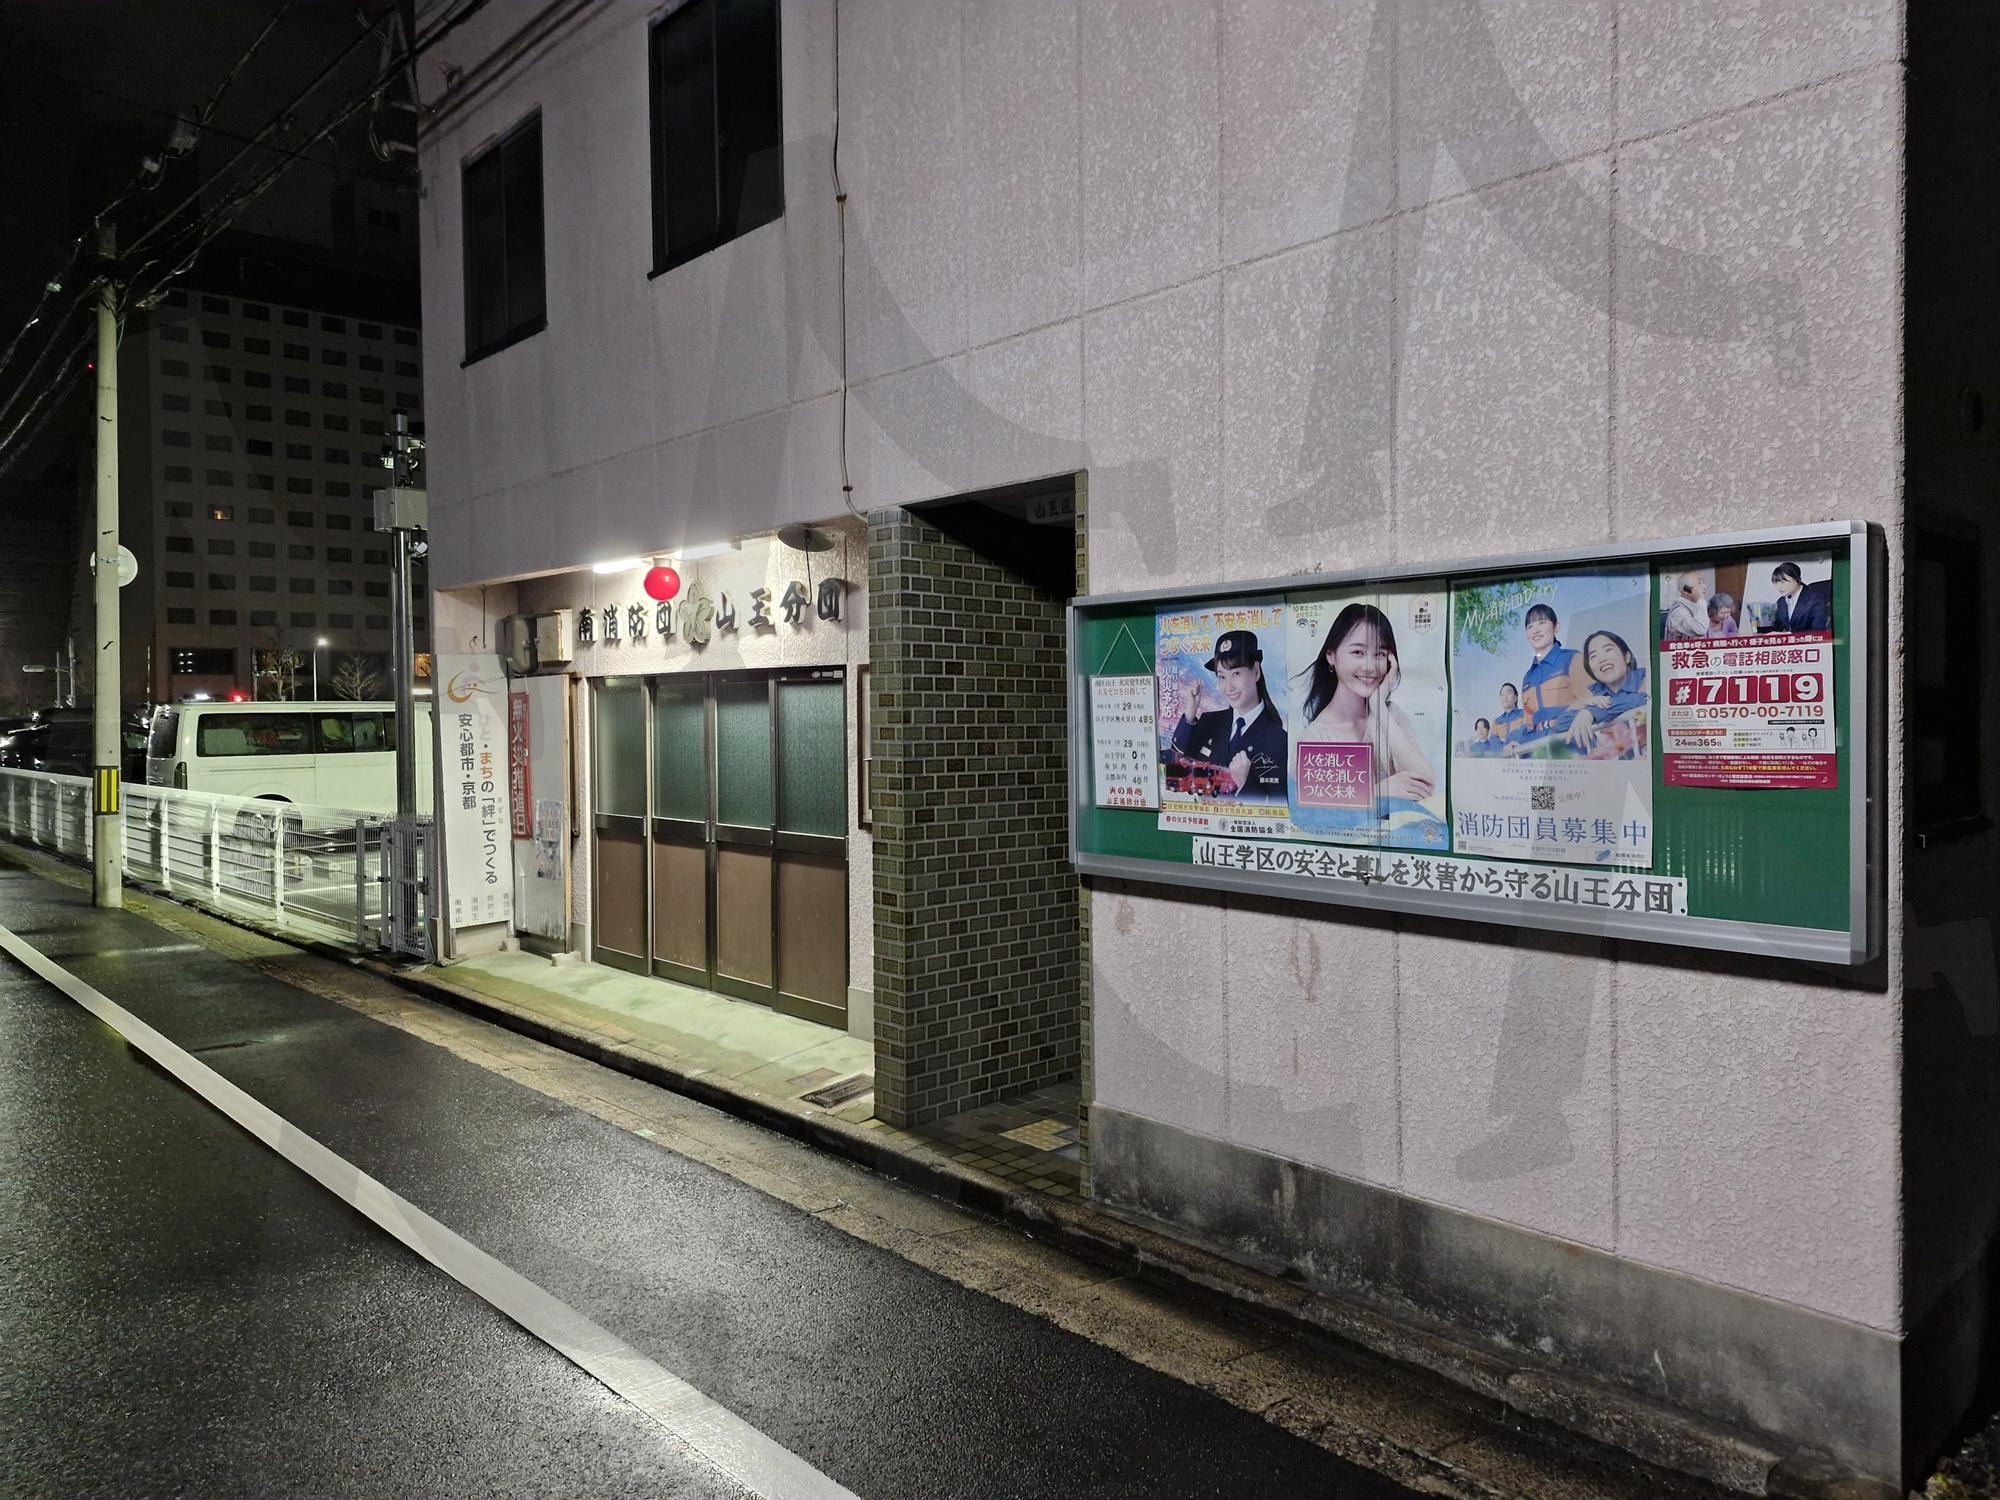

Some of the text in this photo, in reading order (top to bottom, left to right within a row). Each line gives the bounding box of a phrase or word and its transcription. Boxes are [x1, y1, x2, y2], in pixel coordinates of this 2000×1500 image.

[578, 578, 844, 641] 南消防団 山王分団
[1160, 608, 1283, 634] 火を消して 不安を消して
[1160, 636, 1211, 656] つなぐ未来
[1671, 648, 1820, 670] 救急の電話相談窓口
[1161, 666, 1172, 719] 火災予防
[1675, 675, 1819, 704] #7119
[1122, 702, 1132, 711] 29
[1709, 705, 1824, 719] 0570-00-7119
[1123, 739, 1133, 748] 29
[458, 713, 477, 810] 安心都市・京都
[1131, 750, 1138, 760] 0
[1303, 752, 1356, 768] 火を消して
[1303, 768, 1367, 784] 不安を消して
[1303, 784, 1357, 800] つなぐ未来
[1230, 825, 1273, 834] 全国消防協会
[1457, 811, 1647, 846] 消防団員募集中
[1199, 841, 1675, 914] 山王学区の安全と暮しを災害から守る山王分団
